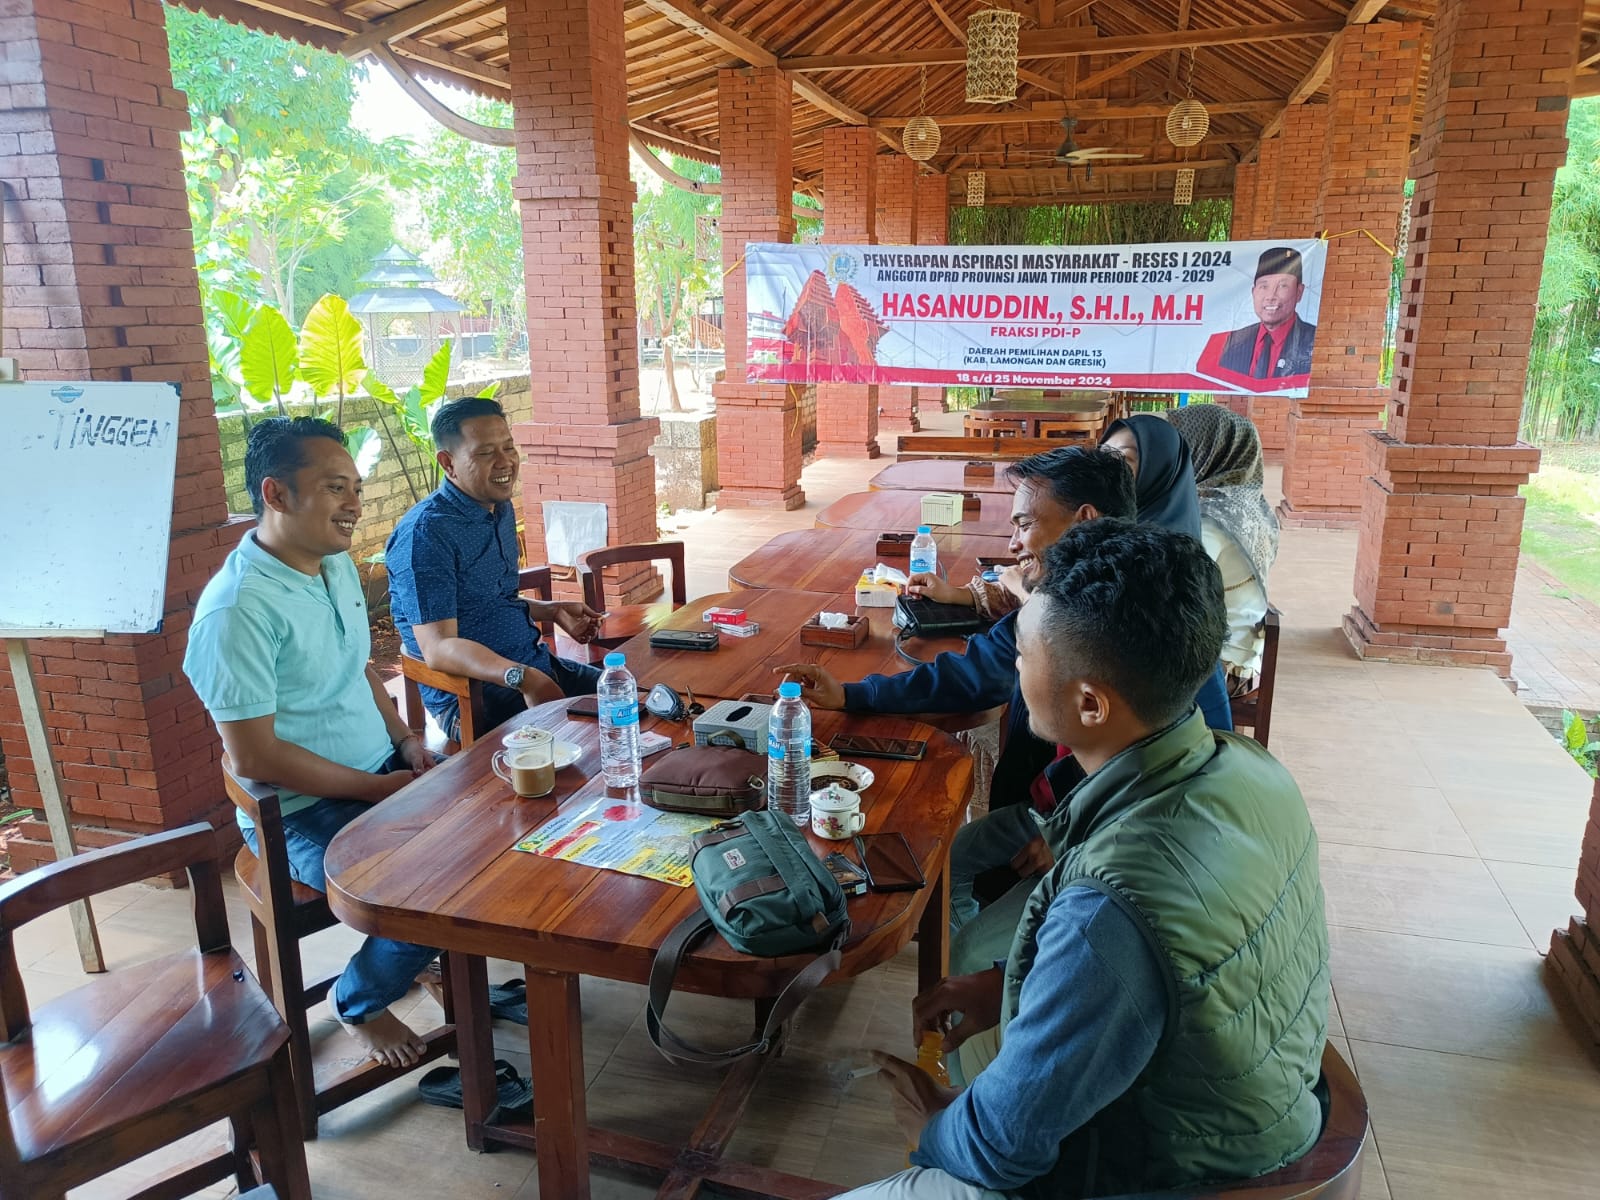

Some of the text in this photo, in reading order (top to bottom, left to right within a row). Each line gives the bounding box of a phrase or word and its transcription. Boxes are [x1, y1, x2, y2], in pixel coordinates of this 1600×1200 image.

[864, 254, 950, 269] PENYERAPAN
[952, 254, 1018, 270] ASPIRASI
[1022, 253, 1120, 270] MASYARAKAT
[1132, 252, 1179, 268] RESES
[1182, 252, 1188, 267] I
[1191, 251, 1232, 267] 2024
[877, 270, 927, 282] ANGGOTA
[929, 271, 959, 283] DPRD
[961, 271, 1014, 283] PROVINSI
[1017, 271, 1048, 283] JAWA
[1051, 271, 1087, 283] TIMUR
[1090, 271, 1139, 283] PERIODE
[1141, 270, 1172, 283] 2024
[1182, 269, 1215, 283] 2029
[882, 293, 1204, 326] HASANUDDIN., S.H.I., M.H
[990, 326, 1081, 338] FRAKSI PDI-P
[968, 347, 1006, 356] DAERAH
[1008, 348, 1059, 357] PEMILIHAN
[1061, 349, 1090, 357] DAPIL
[963, 356, 1106, 368] (KAB. LAMONGAN DAN GRESIK)
[956, 373, 1112, 386] 18 s/d 25 November 2024
